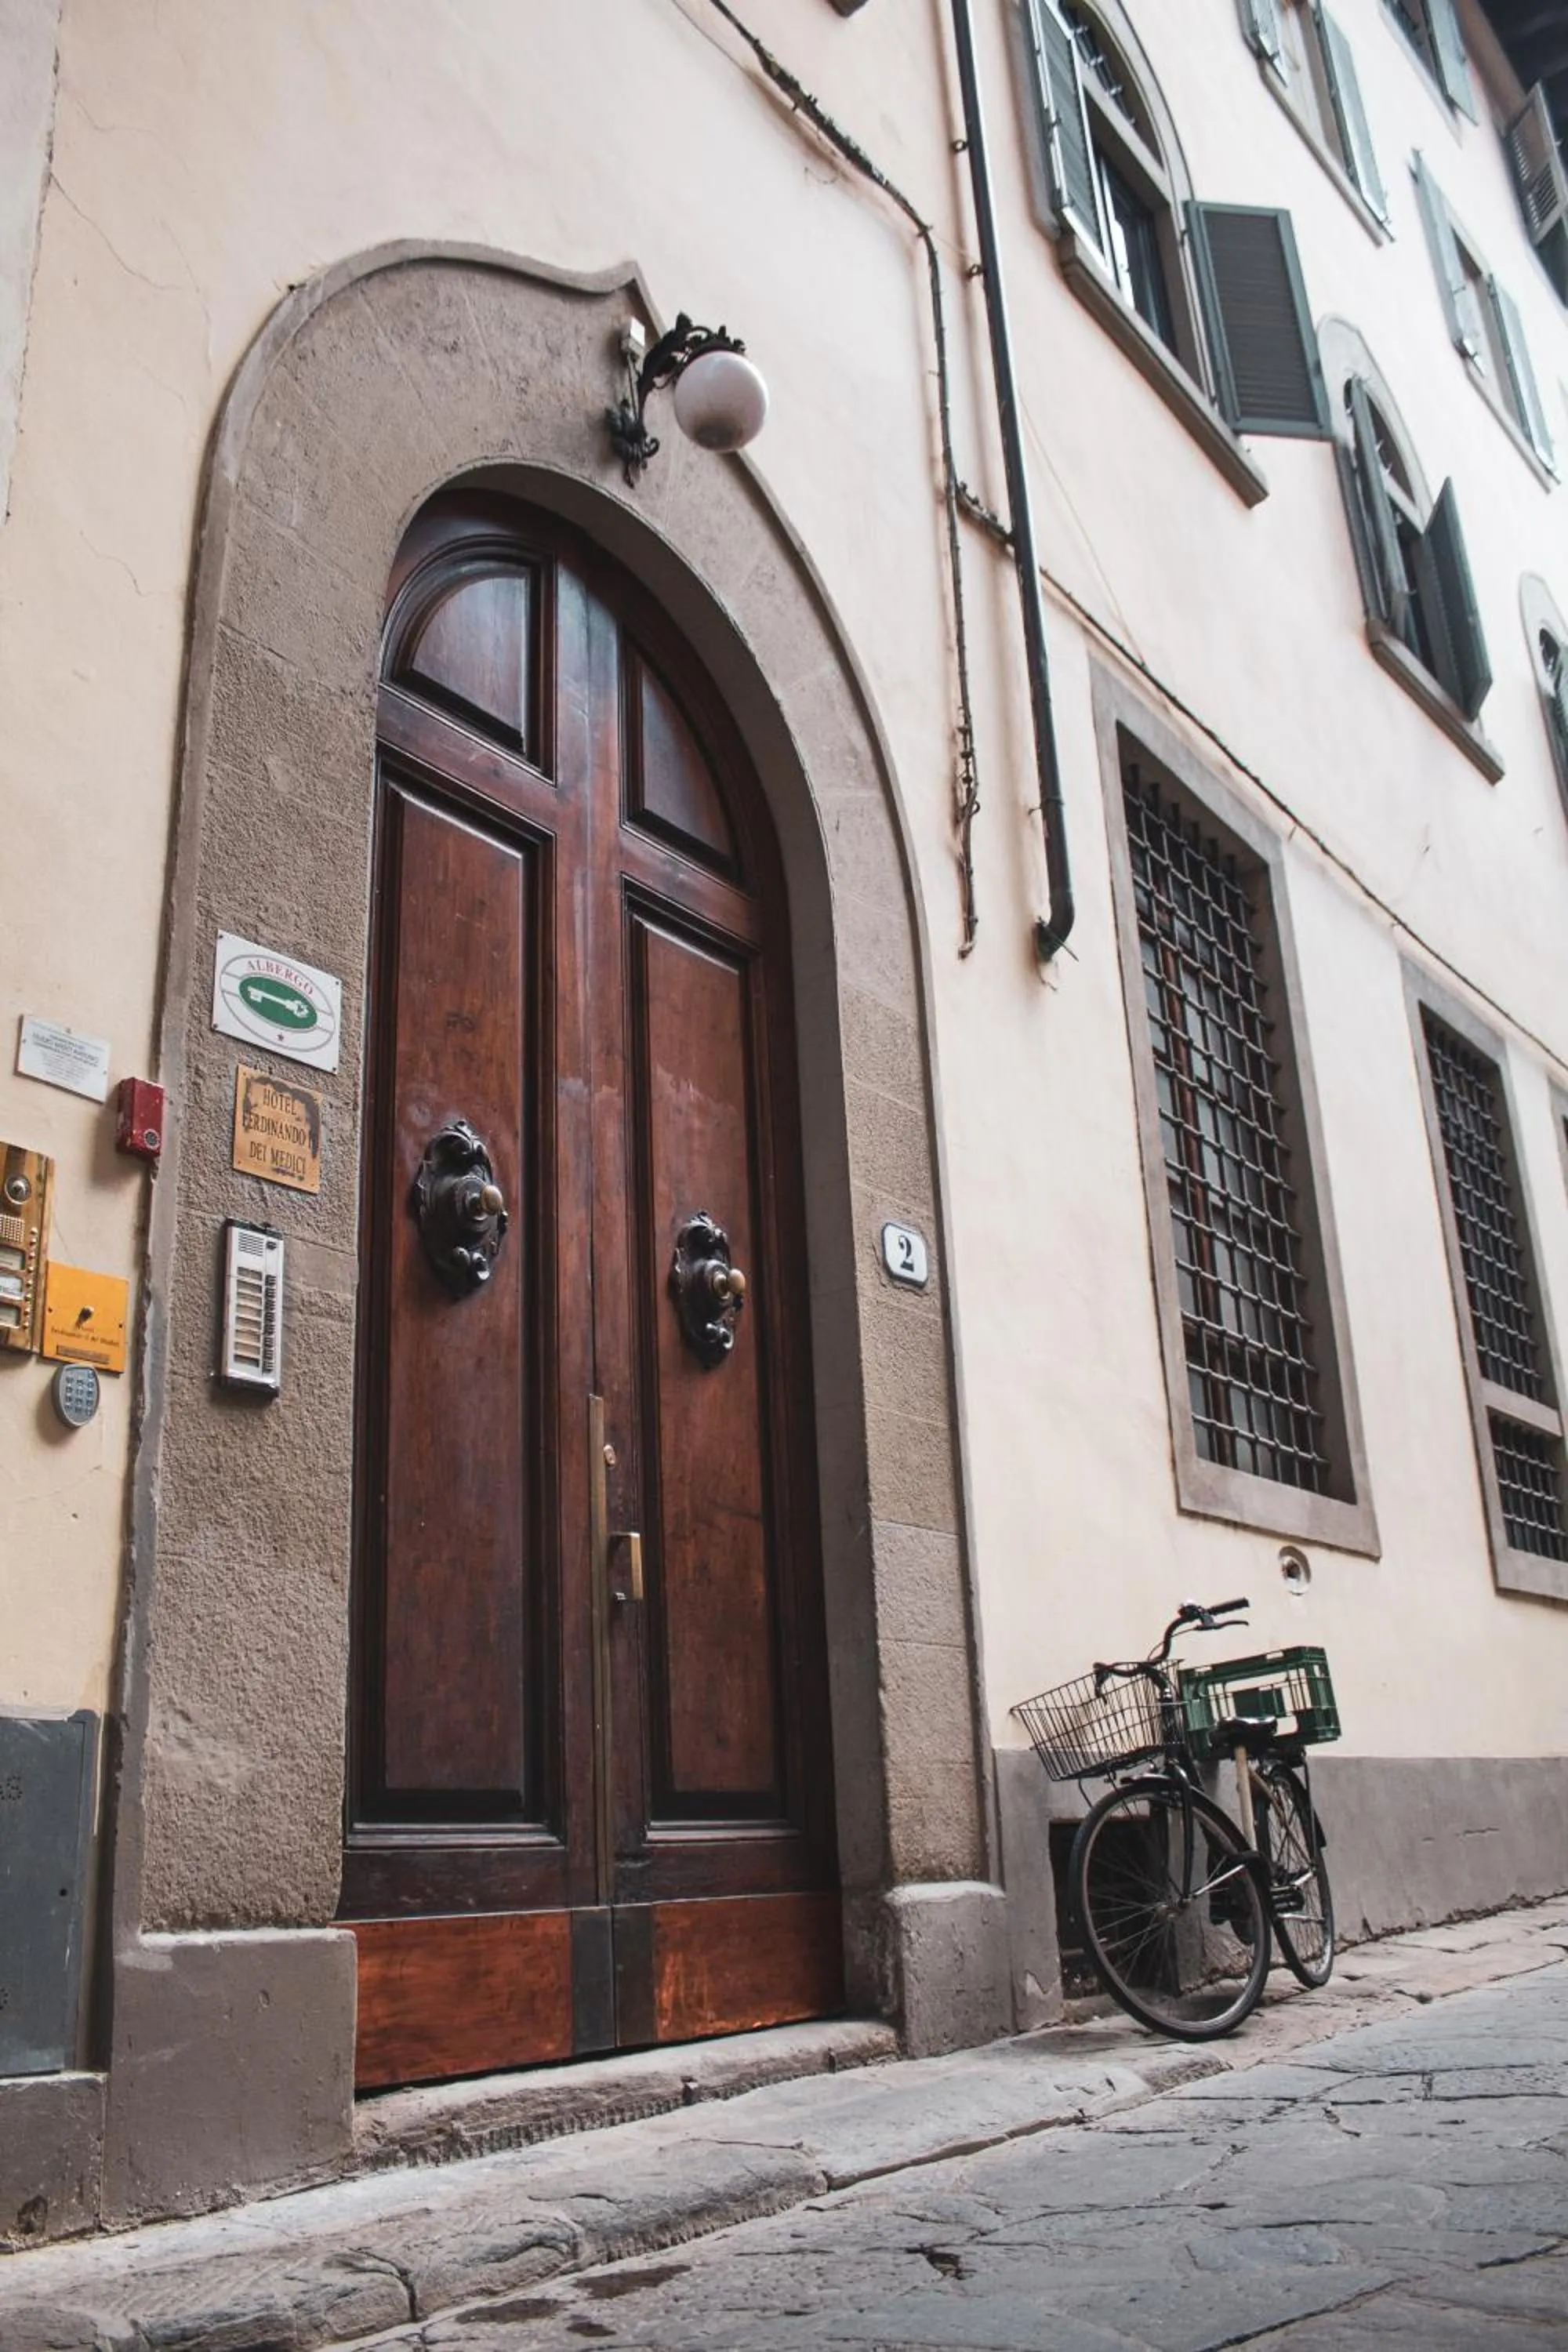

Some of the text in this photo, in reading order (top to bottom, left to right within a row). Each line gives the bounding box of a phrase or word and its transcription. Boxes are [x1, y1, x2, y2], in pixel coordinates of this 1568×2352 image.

[248, 960, 314, 995] ALBERGO
[263, 1087, 297, 1115] HOTEL
[249, 1141, 306, 1175] DEI MEDICI
[898, 1233, 915, 1273] 2
